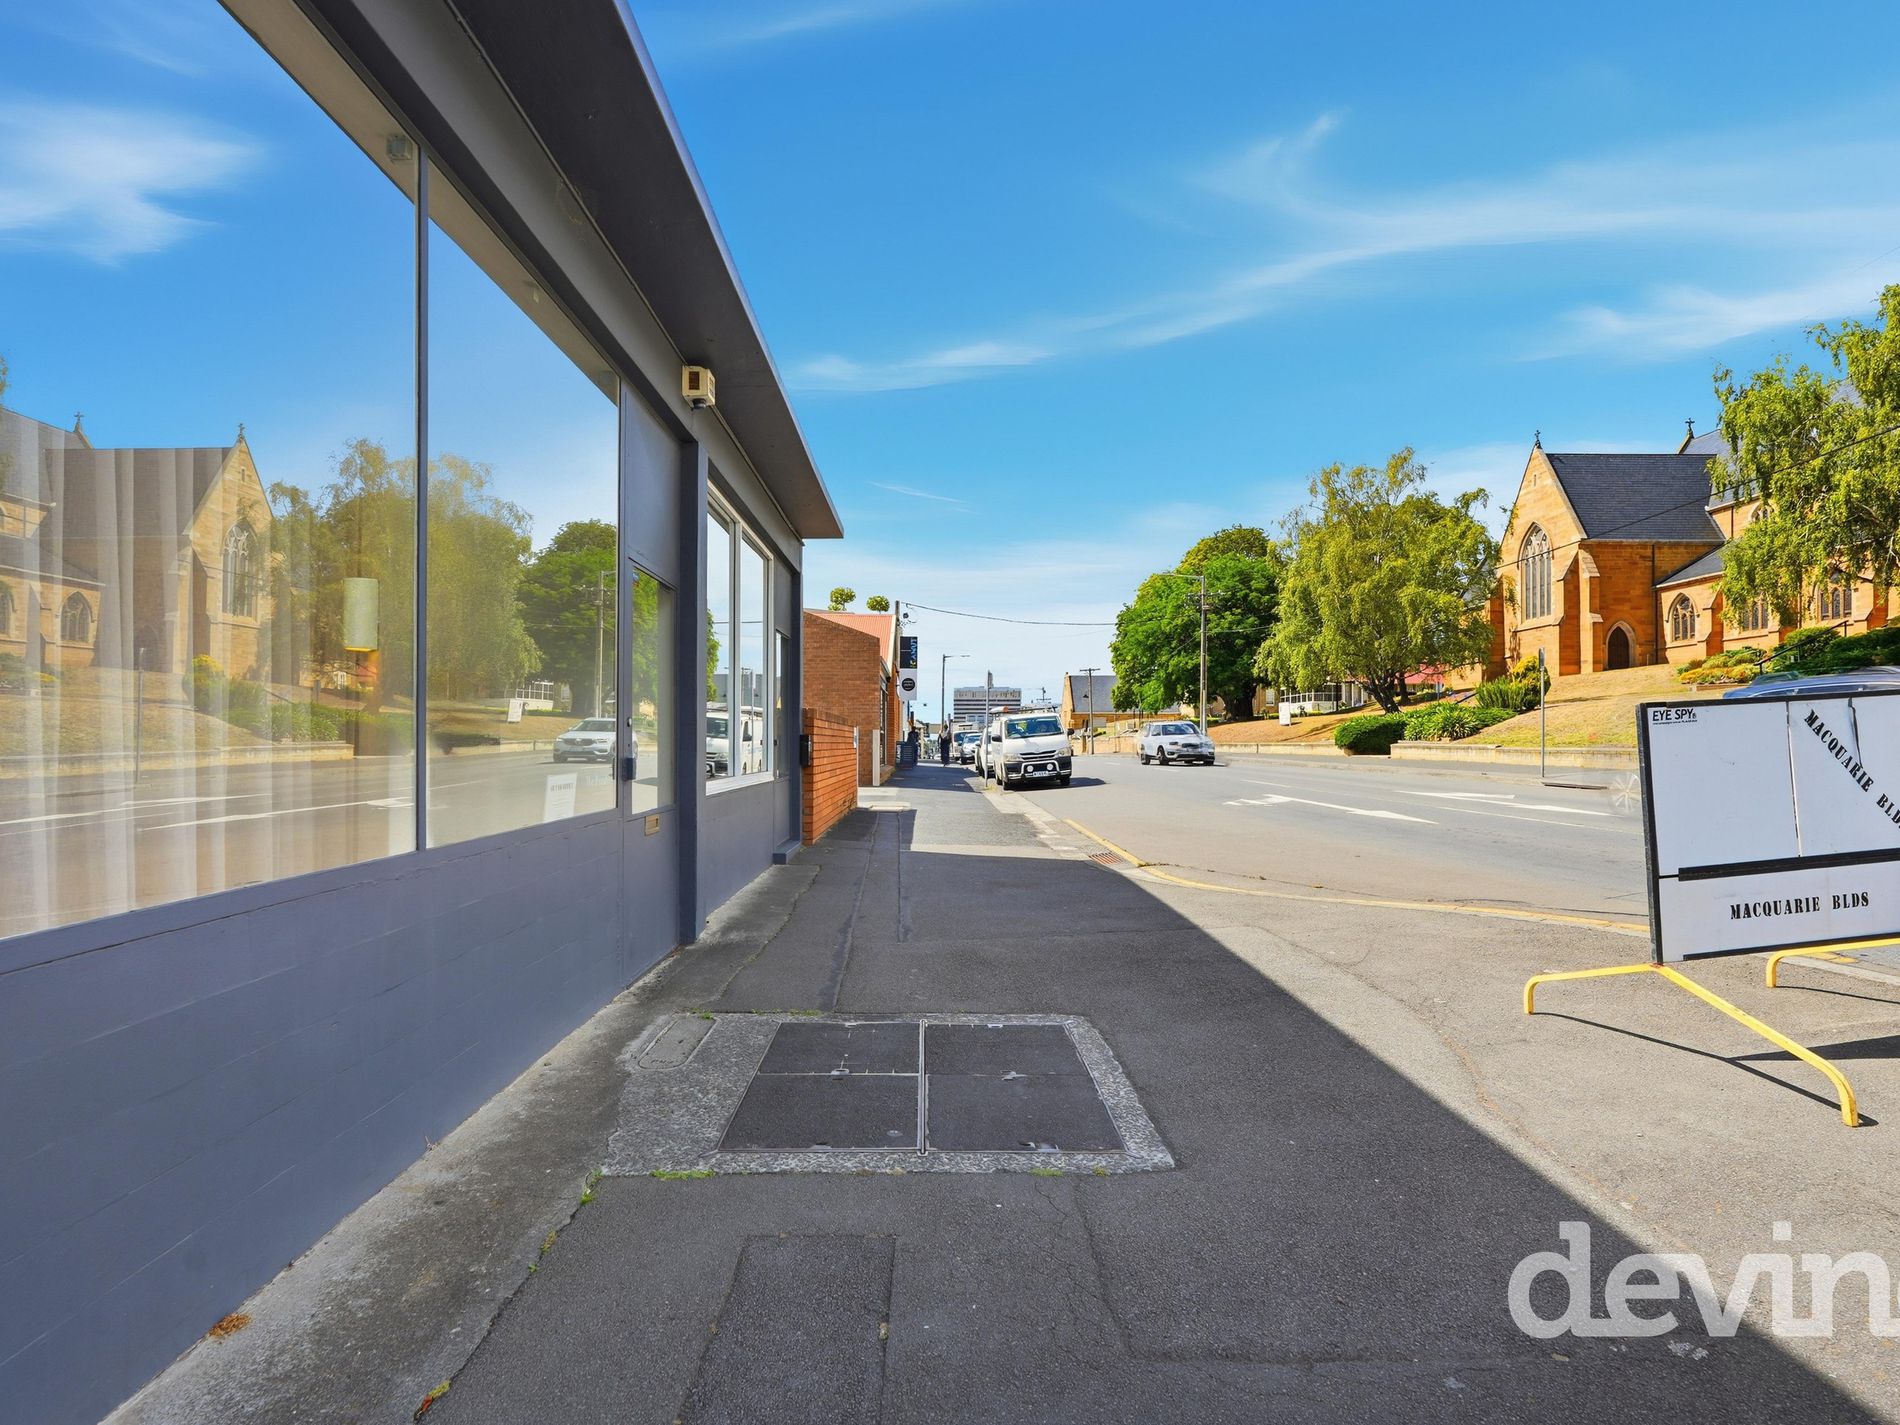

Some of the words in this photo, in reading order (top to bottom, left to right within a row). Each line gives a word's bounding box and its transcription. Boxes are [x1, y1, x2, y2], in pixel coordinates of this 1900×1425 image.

[1652, 710, 1672, 721] EYE
[1803, 709, 1874, 793] MACQUARIE
[1876, 793, 1900, 830] BLD
[1729, 896, 1821, 920] MACQUARIE
[1832, 891, 1870, 910] BLDS
